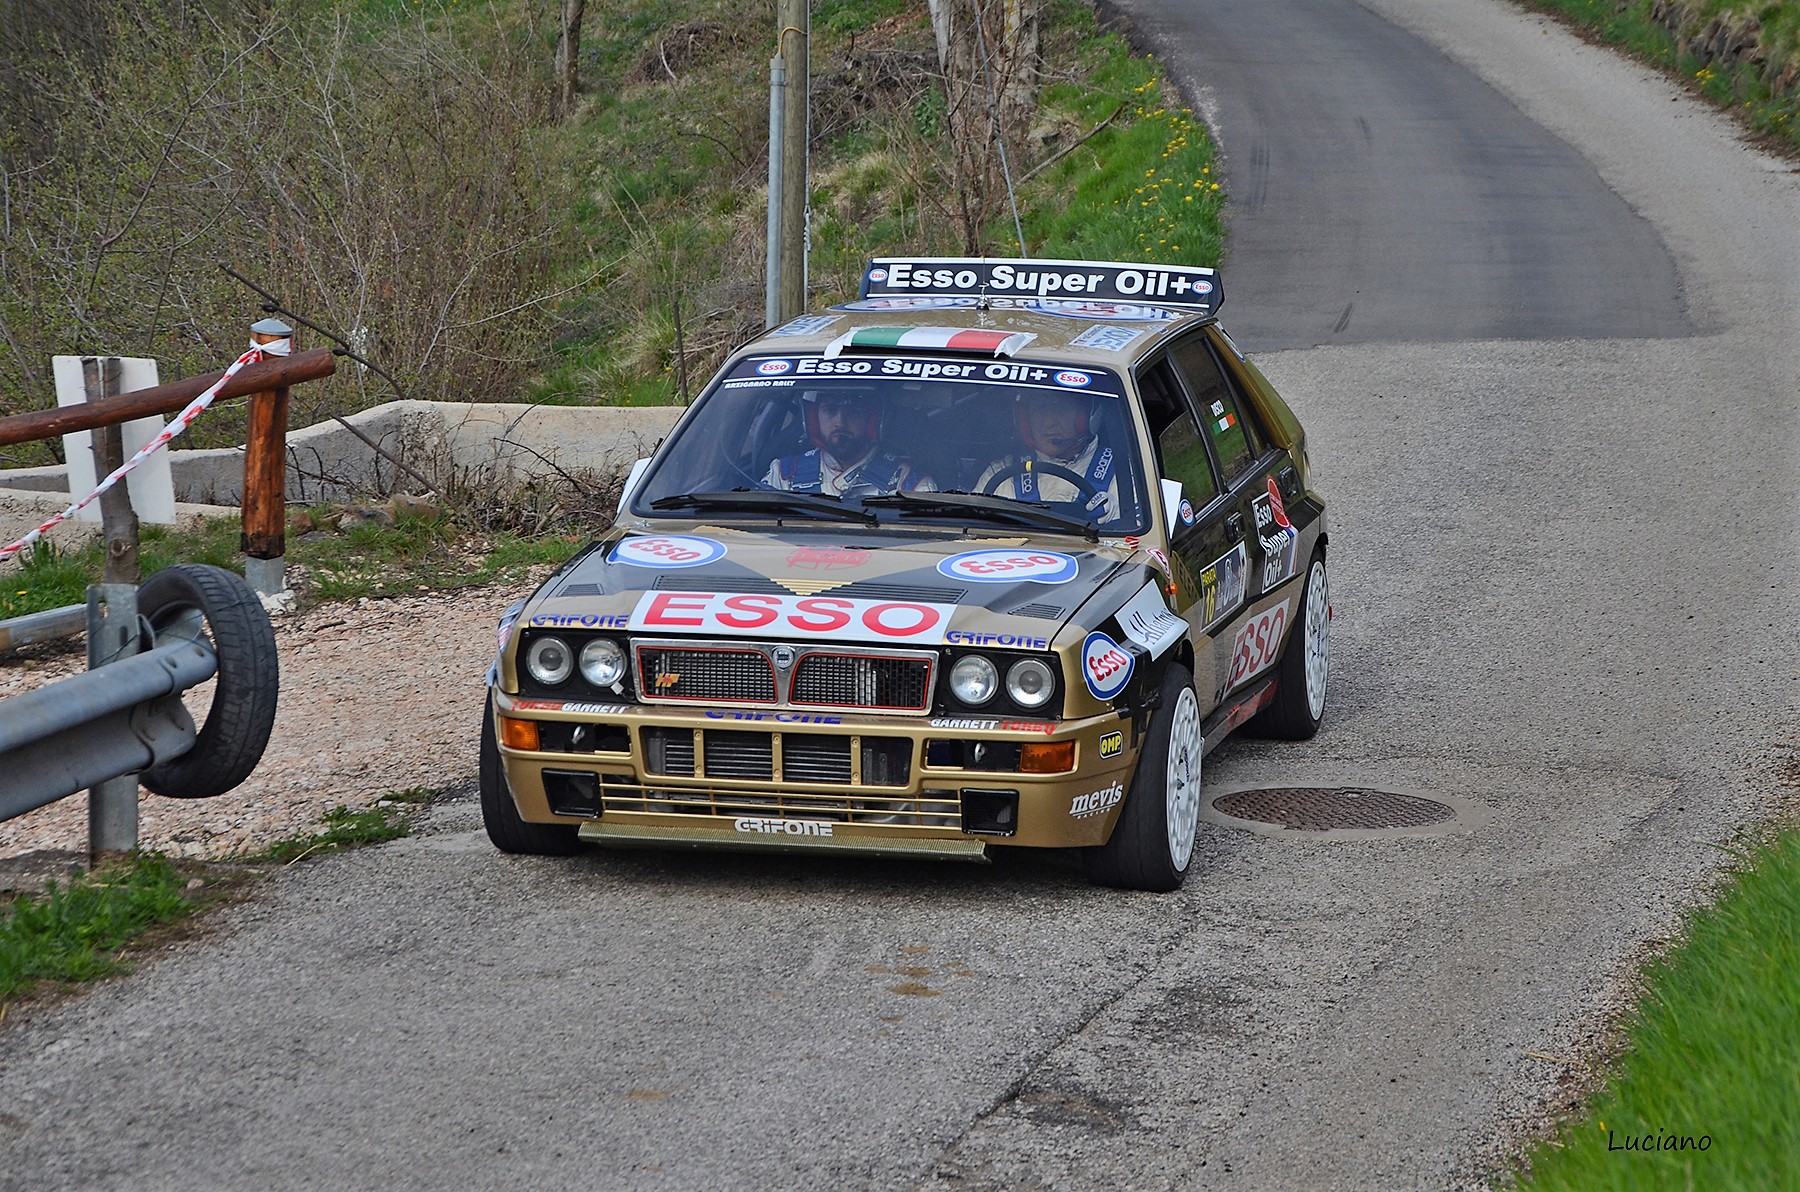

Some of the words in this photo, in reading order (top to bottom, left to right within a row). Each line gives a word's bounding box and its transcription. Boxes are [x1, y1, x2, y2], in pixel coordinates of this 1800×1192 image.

[887, 264, 978, 289] Esso
[989, 265, 1105, 296] Super
[1115, 270, 1192, 296] Oil+
[796, 359, 872, 374] Esso
[881, 359, 977, 378] Super
[984, 364, 1048, 381] Oil+
[1093, 447, 1113, 480] sparco
[1254, 503, 1273, 529] Esso
[1260, 529, 1291, 557] Super
[1265, 559, 1283, 587] Oil+
[643, 593, 940, 637] ESSO
[1205, 585, 1216, 625] 16
[532, 613, 630, 628] GRIFONE
[946, 631, 1047, 649] GRIFONE
[1225, 607, 1285, 693] ESSO
[562, 702, 629, 714] GARRETT
[930, 719, 999, 730] GARRETT
[1002, 721, 1057, 735] TURBO
[1101, 735, 1122, 755] OMP
[1069, 780, 1124, 815] mevis
[734, 818, 834, 837] GRIFONE
